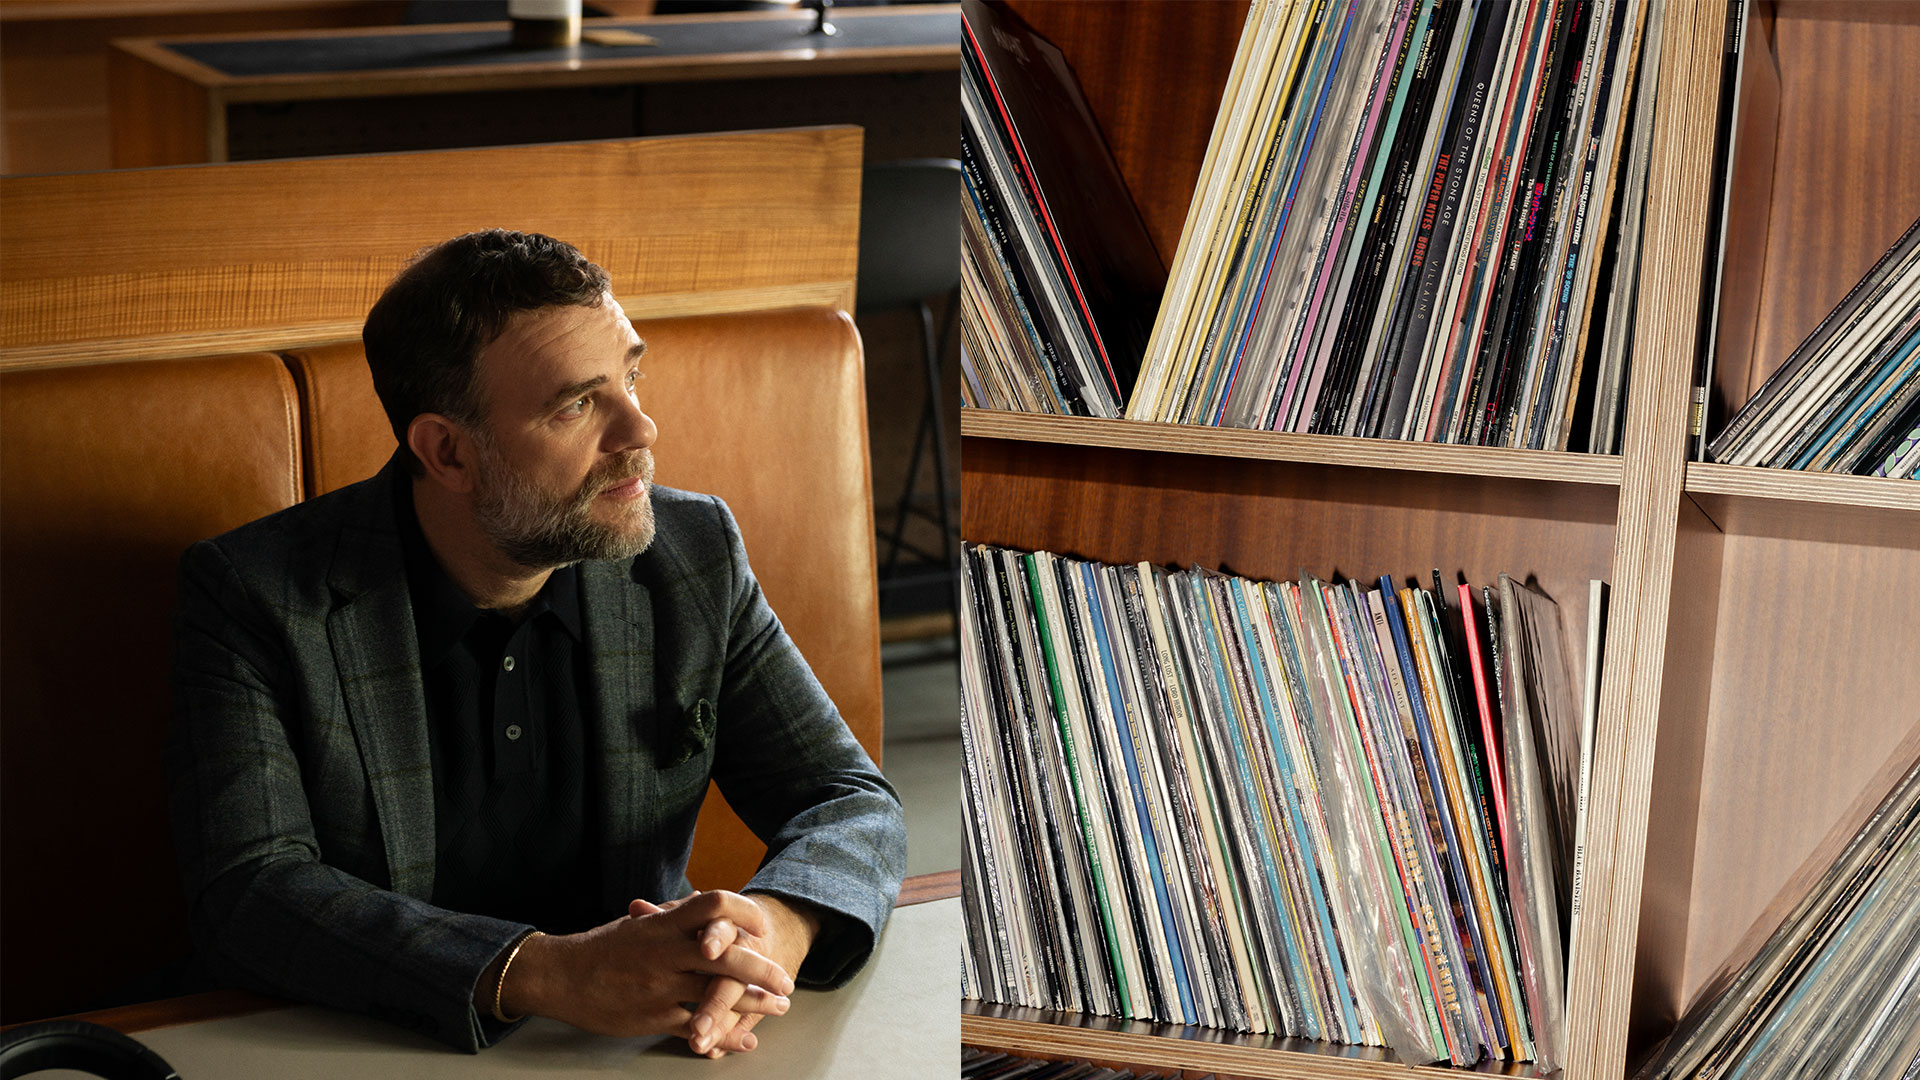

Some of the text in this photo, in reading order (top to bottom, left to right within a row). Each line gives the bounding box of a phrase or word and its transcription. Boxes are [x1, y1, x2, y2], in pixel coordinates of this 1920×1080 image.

[1401, 160, 1409, 172] EVE
[1437, 152, 1450, 166] THE
[1501, 154, 1512, 175] KOJEY
[1549, 153, 1555, 161] OF
[1395, 172, 1406, 193] ADAMS
[1428, 171, 1445, 201] PAPER
[1475, 182, 1484, 195] LAST
[1478, 171, 1486, 182] THE
[961, 143, 1008, 244] DEAD WEATHER SEA OF COWARDS
[1341, 190, 1353, 211] bottle
[1416, 81, 1485, 320] QUEENS OF THE STONE AGE VILLAINS
[1494, 176, 1507, 204] RADICAL
[1517, 177, 1534, 229] The White Stripes
[1338, 215, 1345, 223] in
[1420, 201, 1437, 230] KITES
[1468, 195, 1481, 224] RESORT:
[1571, 170, 1592, 245] THE GASLIGHT ANTHEM
[1460, 224, 1473, 258] GREETINGS
[1372, 241, 1386, 276] METAL BIRD
[1455, 257, 1465, 276] FROM
[1567, 252, 1576, 268] THE
[1560, 279, 1571, 303] SOUND
[1045, 341, 1058, 362] STEREO
[1475, 409, 1484, 426] XLLP
[1725, 403, 1759, 440] ARCADE FIRE
[1233, 587, 1250, 631] ALEX CAMERON
[1009, 621, 1018, 643] Michigan
[1160, 649, 1182, 718] LONG LOST LORD HURON
[1389, 667, 1398, 687] ALFA
[1395, 690, 1405, 709] MIST
[1064, 726, 1072, 740] THE
[1067, 740, 1076, 757] LOVE
[1281, 767, 1298, 812] MIAMI MEMORY
[1371, 806, 1385, 841] CRUSHING
[1571, 845, 1583, 915] BLUE BANISTERS
